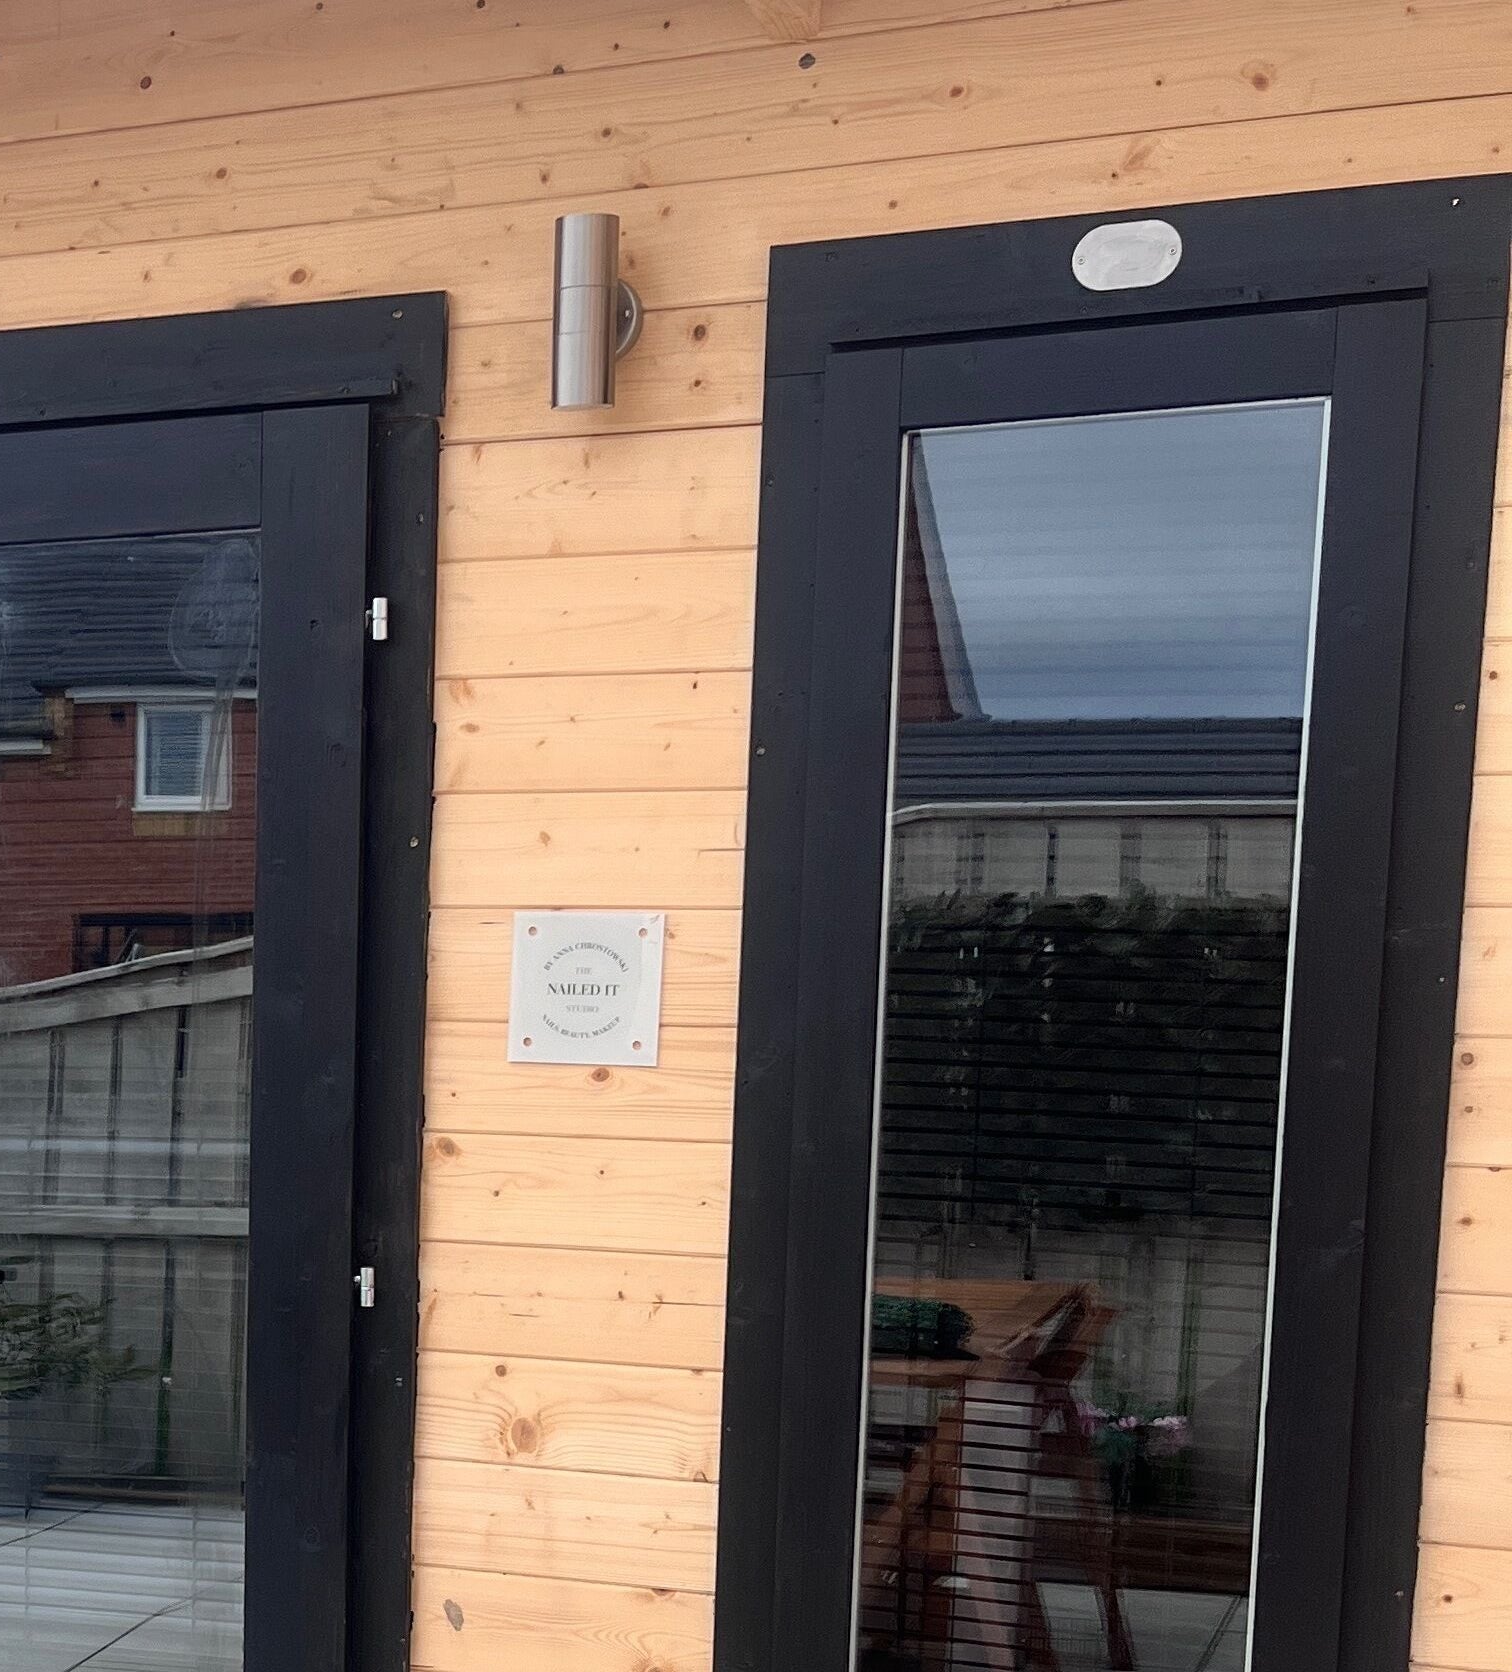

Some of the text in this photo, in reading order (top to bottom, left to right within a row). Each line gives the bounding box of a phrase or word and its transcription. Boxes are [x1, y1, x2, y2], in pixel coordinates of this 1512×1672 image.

[544, 961, 553, 971] BY
[553, 945, 574, 960] ANNA
[575, 967, 592, 975] THE
[547, 983, 620, 996] NAILED IT
[566, 1004, 599, 1013] STUDIO
